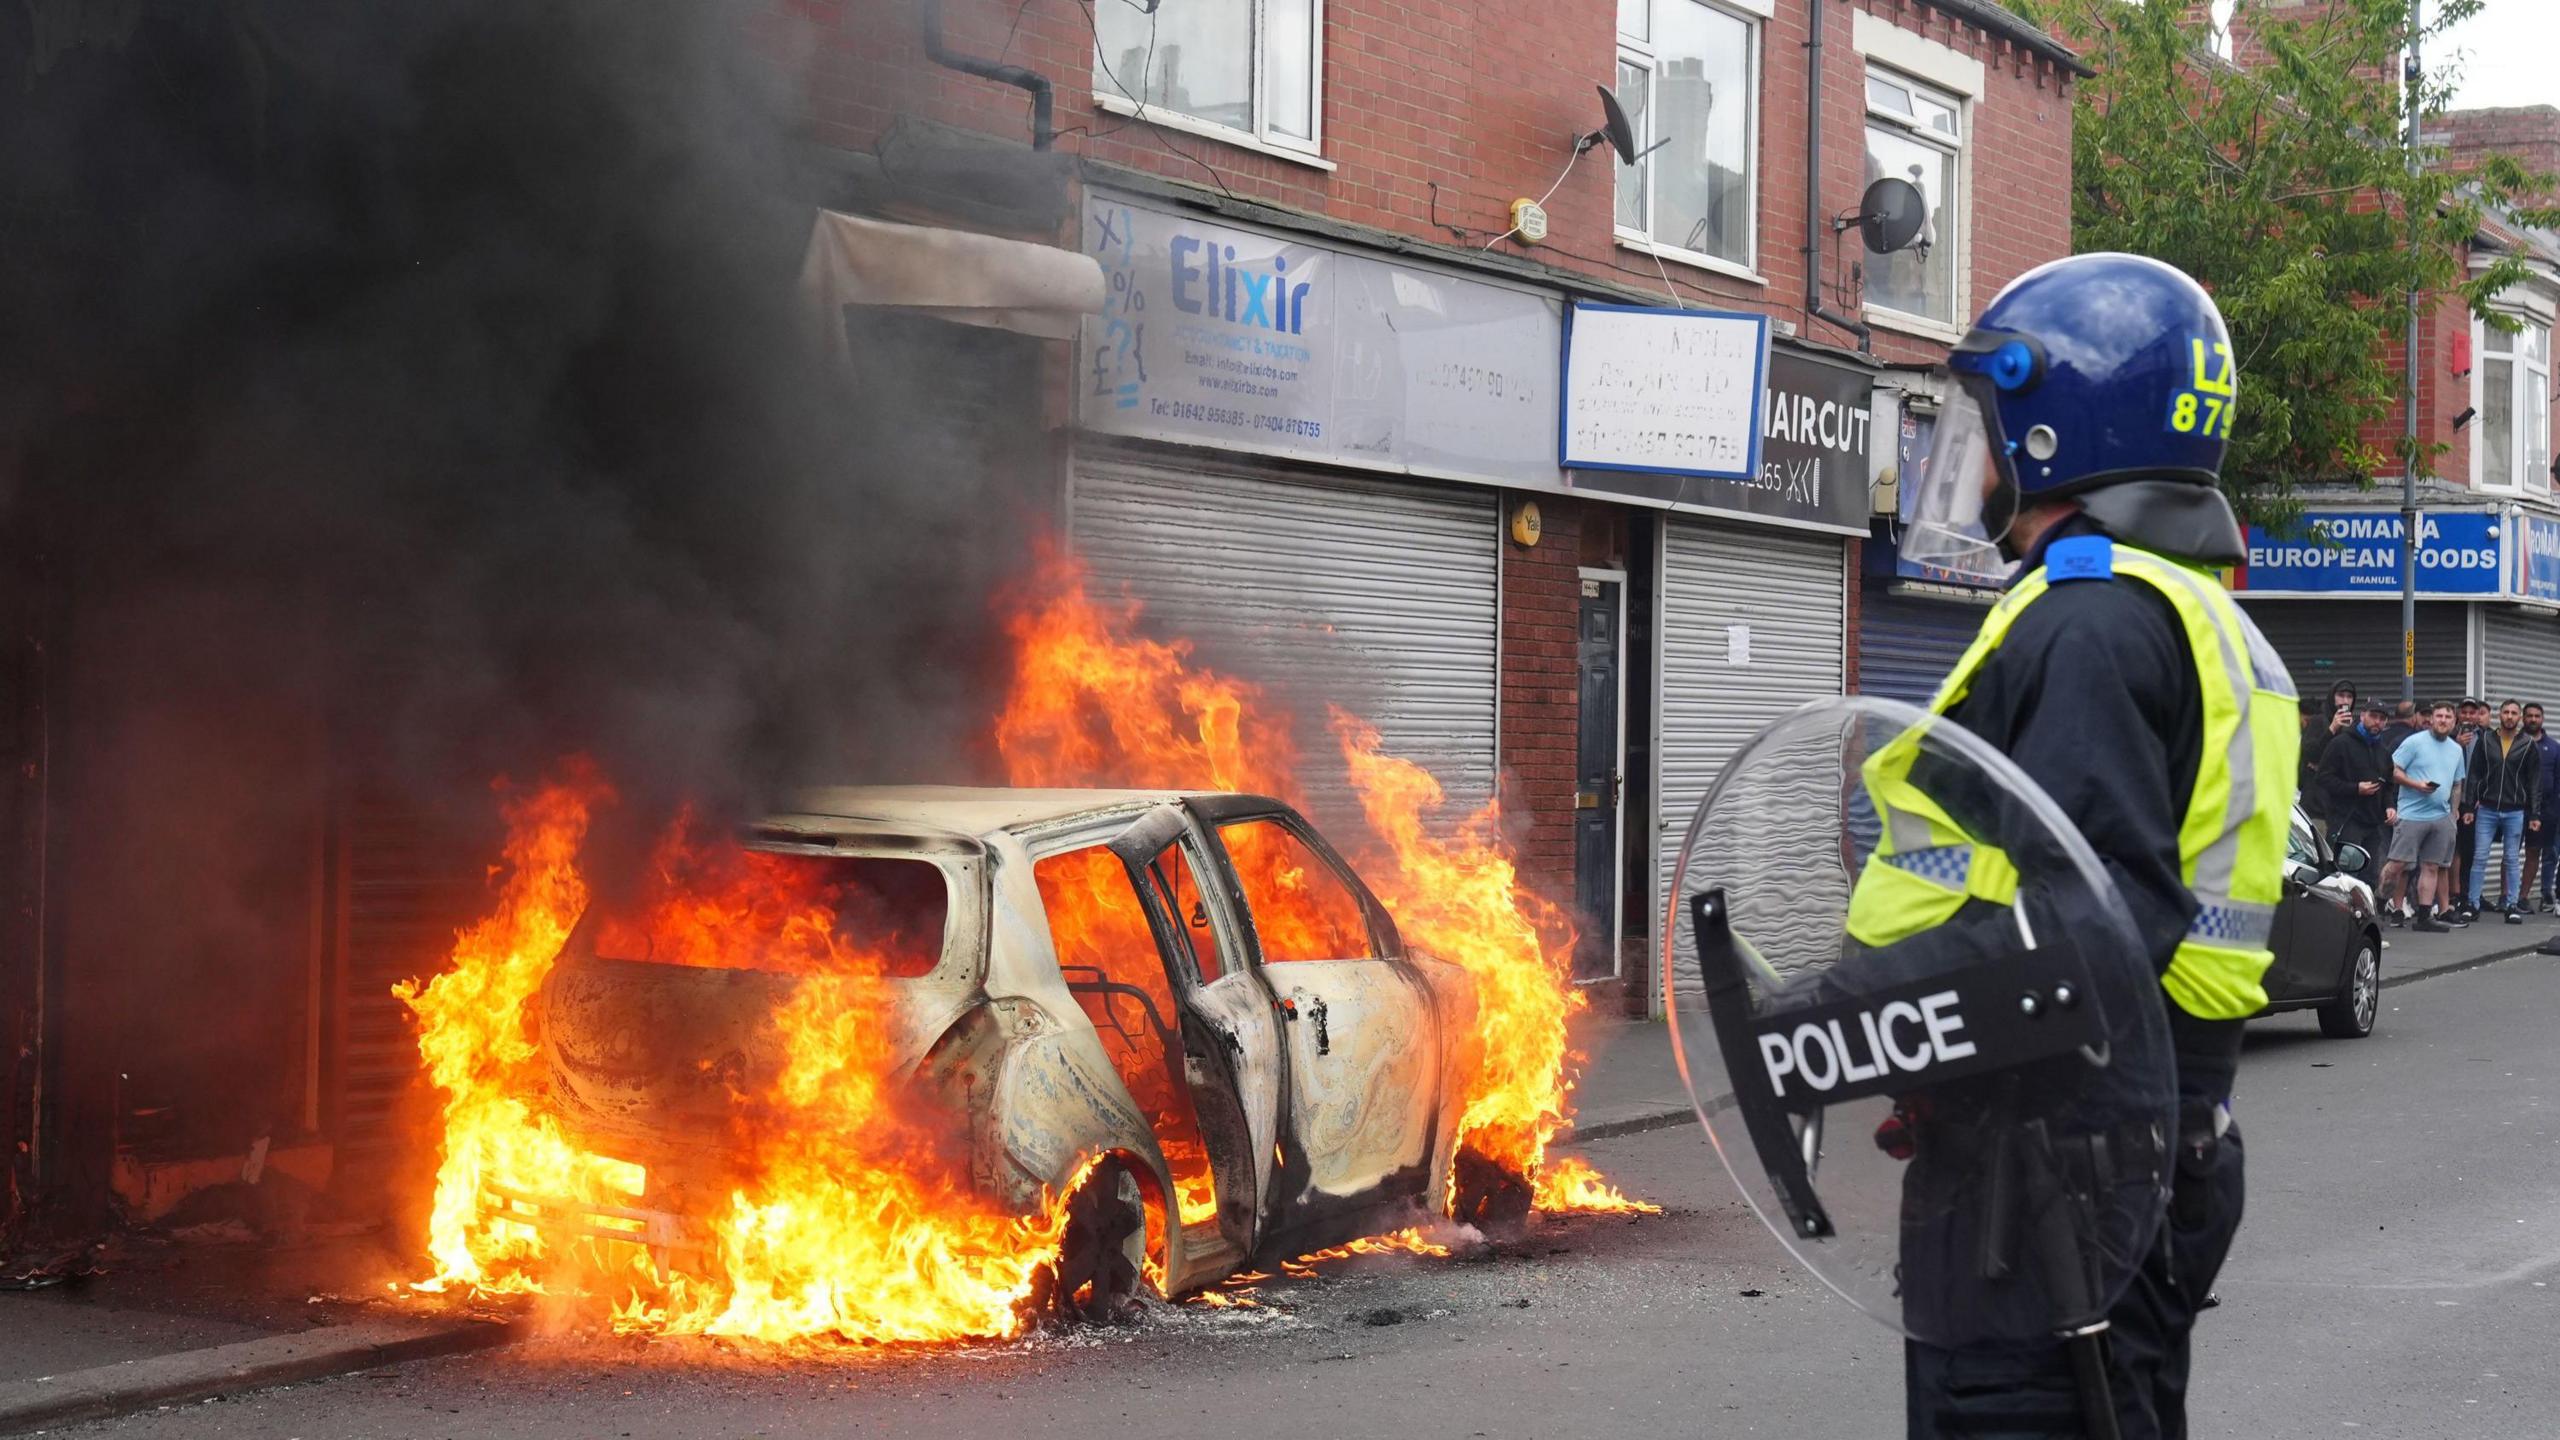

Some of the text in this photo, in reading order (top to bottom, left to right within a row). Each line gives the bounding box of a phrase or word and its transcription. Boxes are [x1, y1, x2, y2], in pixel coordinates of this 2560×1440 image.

[1170, 234, 1311, 335] Elixir
[1172, 400, 1205, 422] 01642
[1525, 515, 1540, 532] Yale
[2249, 548, 2395, 568] EUROPEAN
[2349, 576, 2398, 585] EMANUEL
[1758, 990, 1977, 1097] POLICE
